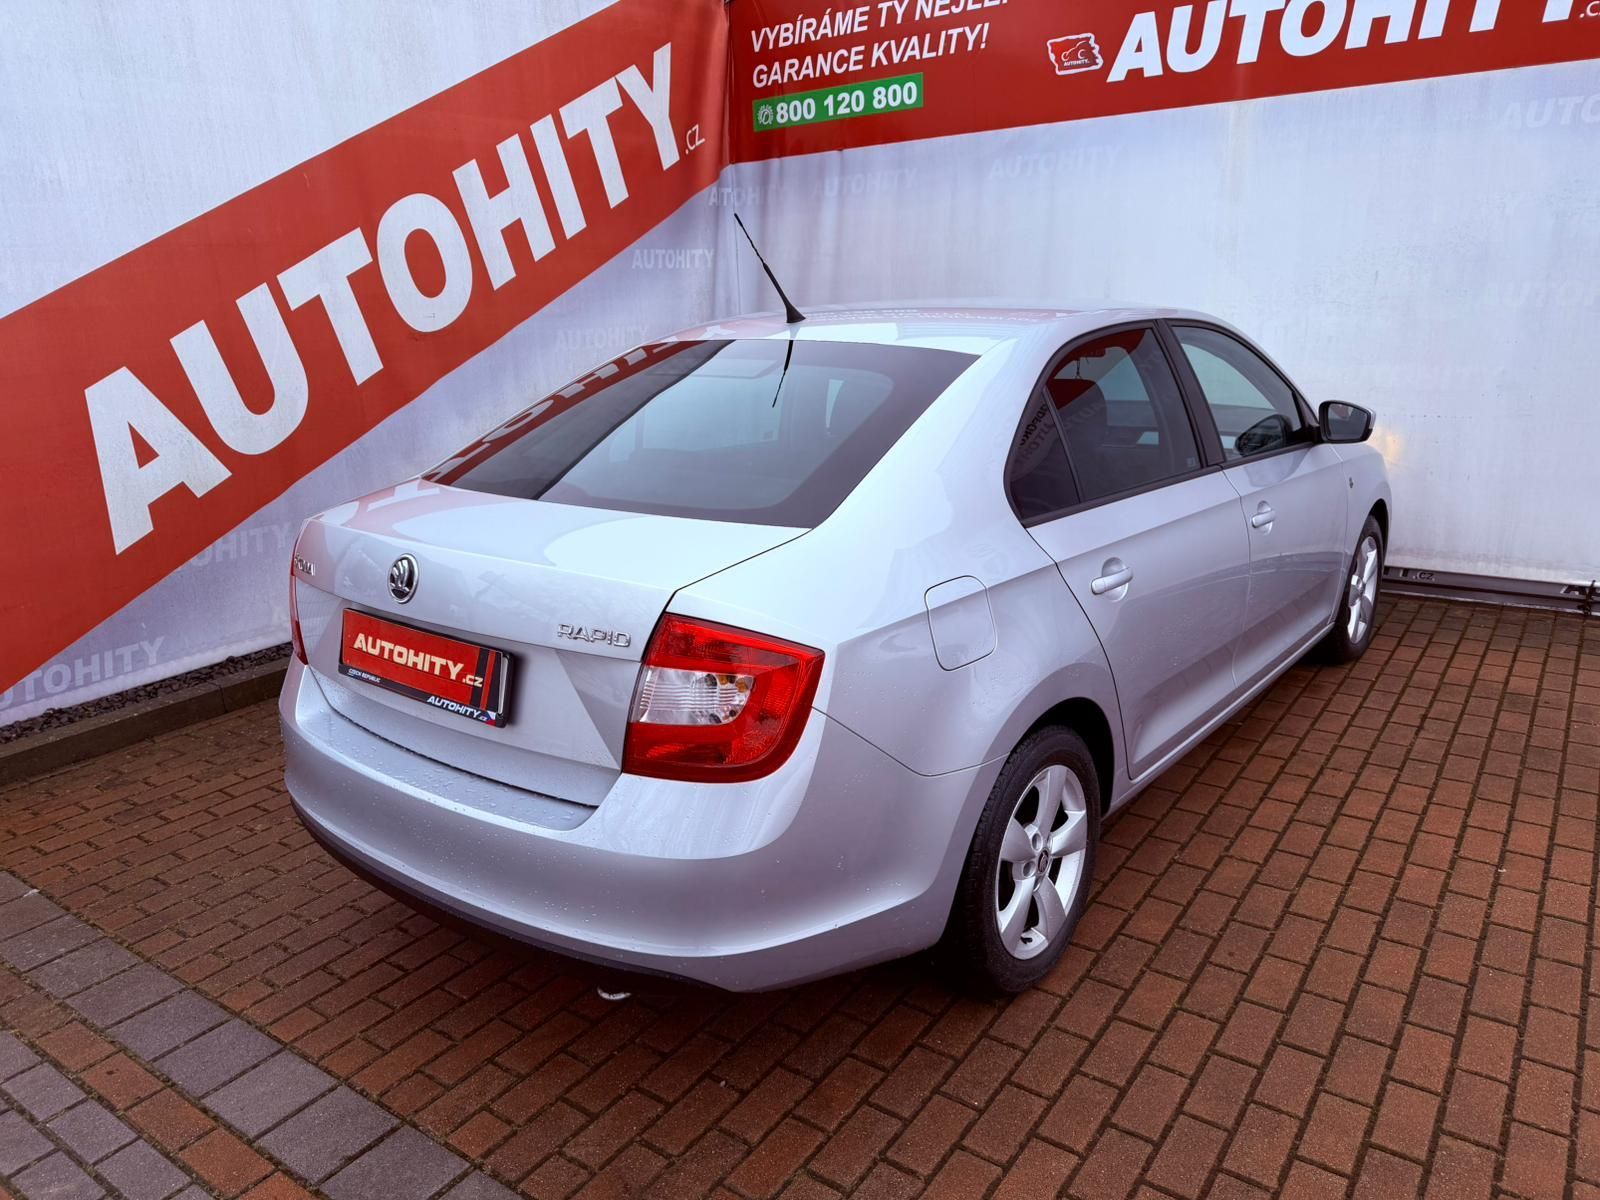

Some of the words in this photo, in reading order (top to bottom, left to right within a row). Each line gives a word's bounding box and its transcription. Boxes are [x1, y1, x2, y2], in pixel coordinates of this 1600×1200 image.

[751, 6, 870, 53] VYBÍRÁME
[877, 0, 909, 28] TY
[752, 45, 866, 88] GARANCE
[870, 22, 991, 68] KVALITY!
[776, 98, 816, 124] 800
[823, 90, 865, 116] 120
[872, 81, 918, 110] 800
[631, 247, 715, 270] AUTOHITY
[558, 624, 631, 647] RAPID
